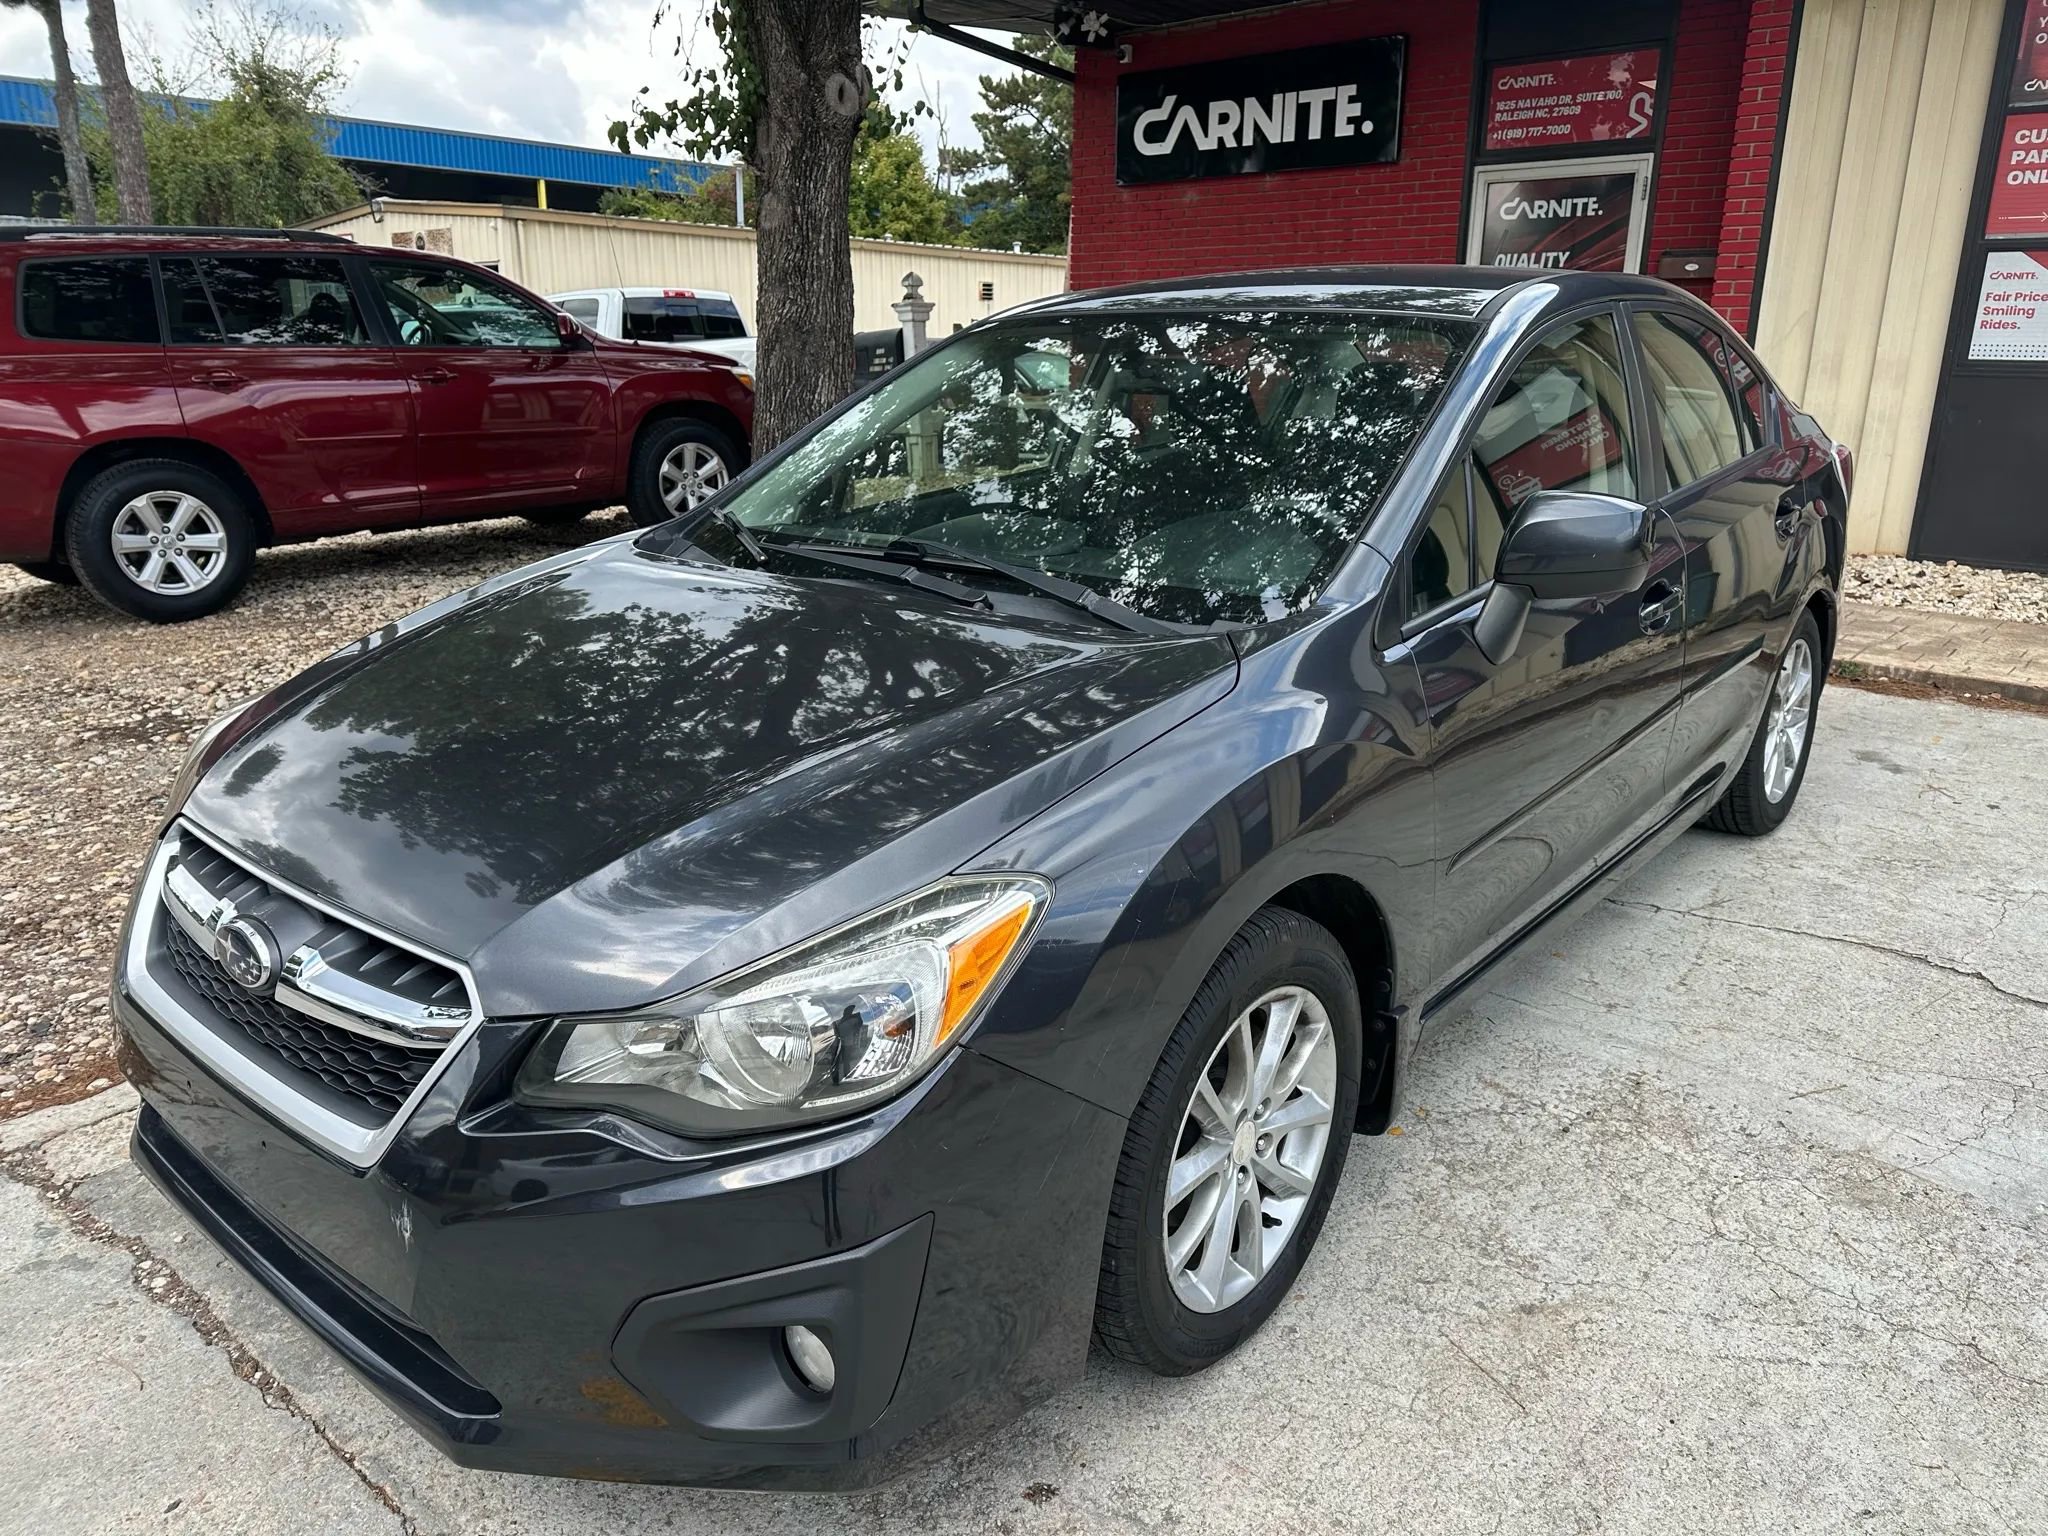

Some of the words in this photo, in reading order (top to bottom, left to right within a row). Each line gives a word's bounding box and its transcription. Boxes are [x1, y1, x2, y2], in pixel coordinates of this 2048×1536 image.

[1496, 100, 1516, 111] 1625
[1516, 97, 1558, 108] NAVAHO
[1558, 94, 1573, 105] DR,
[1575, 91, 1606, 103] SUITE
[1605, 89, 1624, 101] 100,
[1133, 84, 1374, 156] CARNITE.
[1494, 110, 1533, 122] RALEIGH
[1534, 108, 1550, 119] NC,
[1552, 105, 1582, 117] 27609
[1503, 127, 1526, 140] (919)
[1528, 124, 1571, 137] 717-7000
[2015, 128, 2048, 144] CU
[1494, 251, 1570, 268] QUALITY
[1985, 291, 2012, 302] Fair
[1982, 305, 2036, 319] Smiling
[1980, 319, 2021, 330] Rides.
